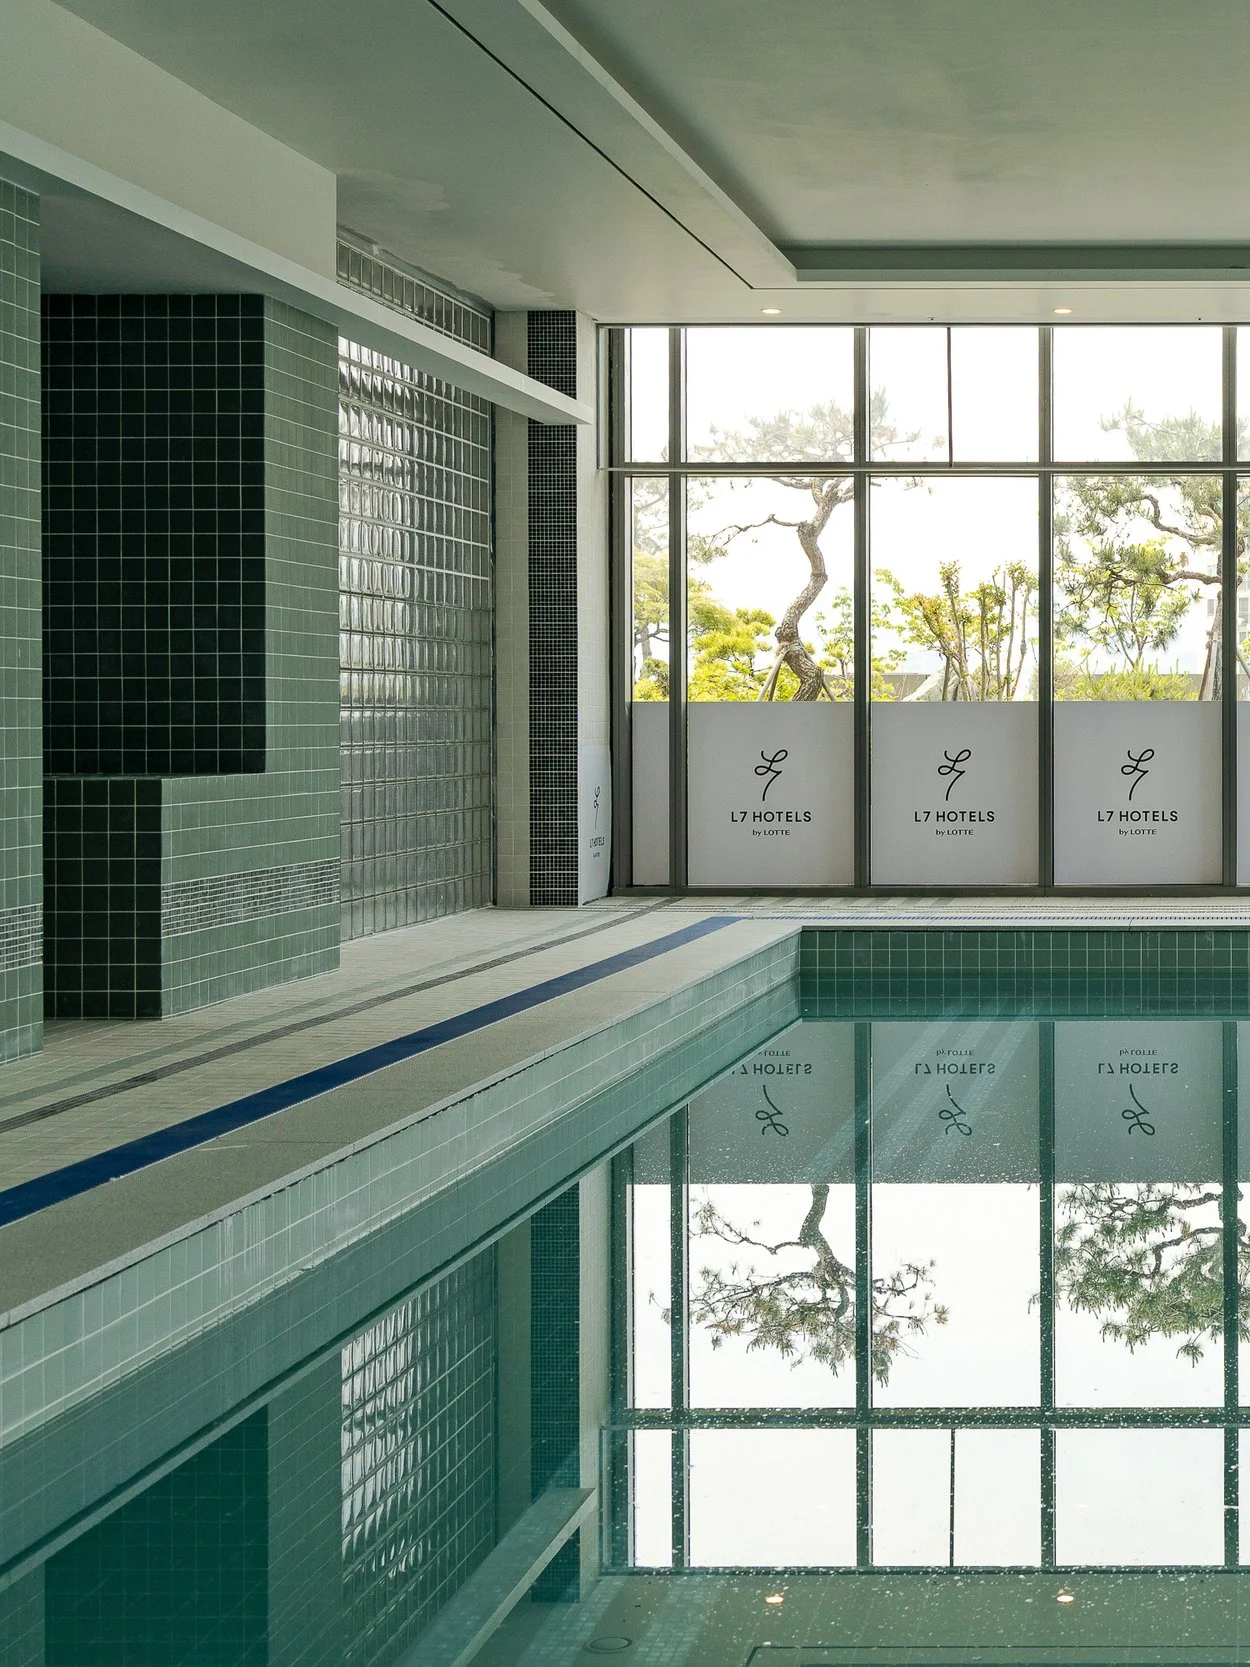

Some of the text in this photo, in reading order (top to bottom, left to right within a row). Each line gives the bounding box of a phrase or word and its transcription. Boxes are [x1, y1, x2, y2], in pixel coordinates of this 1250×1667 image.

[731, 811, 812, 823] L7 HOTELS
[914, 810, 995, 822] L7 HOTELS
[1097, 810, 1178, 822] L7 HOTELS
[752, 828, 791, 838] by LOTTE
[935, 827, 974, 837] by LOTTE
[1118, 827, 1157, 837] by LOTTE
